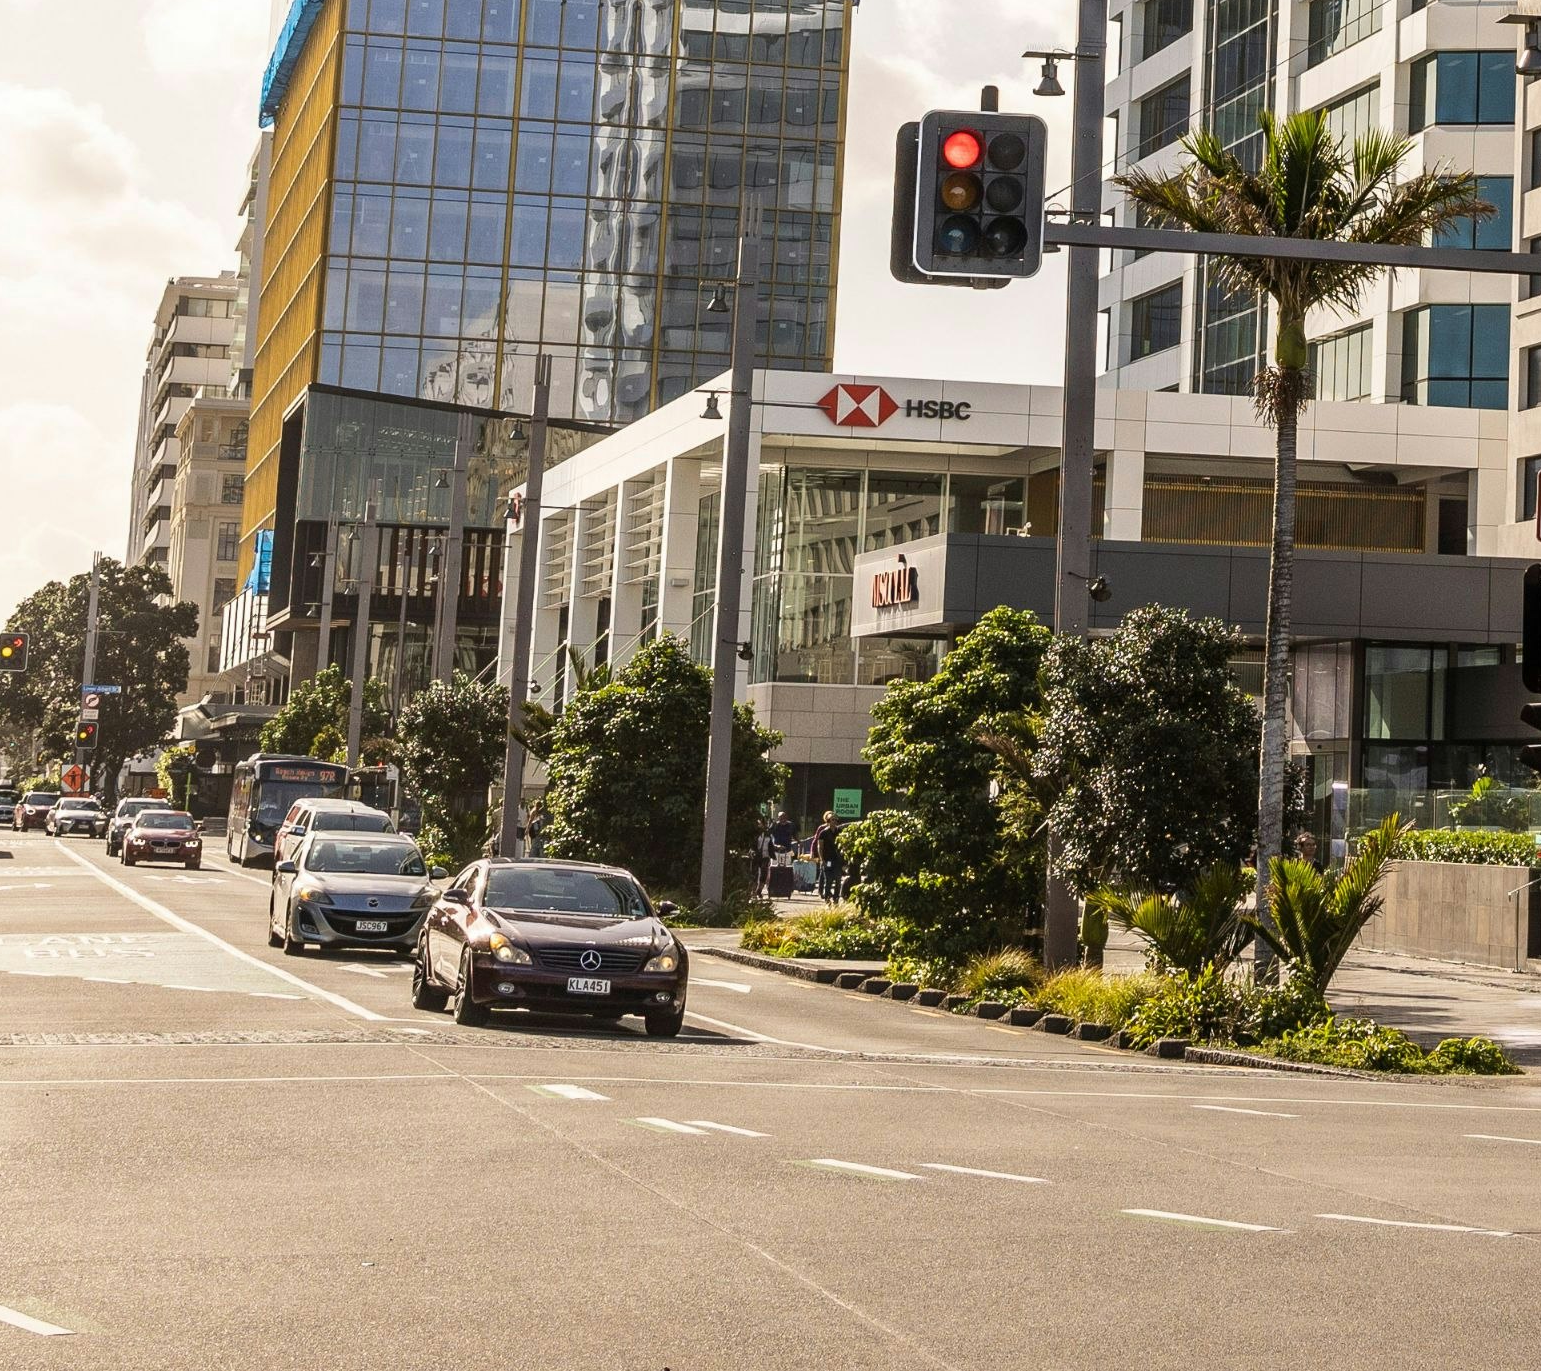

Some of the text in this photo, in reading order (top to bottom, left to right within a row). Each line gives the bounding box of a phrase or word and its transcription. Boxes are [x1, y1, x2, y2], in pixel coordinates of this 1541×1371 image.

[906, 399, 971, 421] HSBC
[357, 922, 386, 930] JSC967
[569, 979, 609, 992] KLA451
